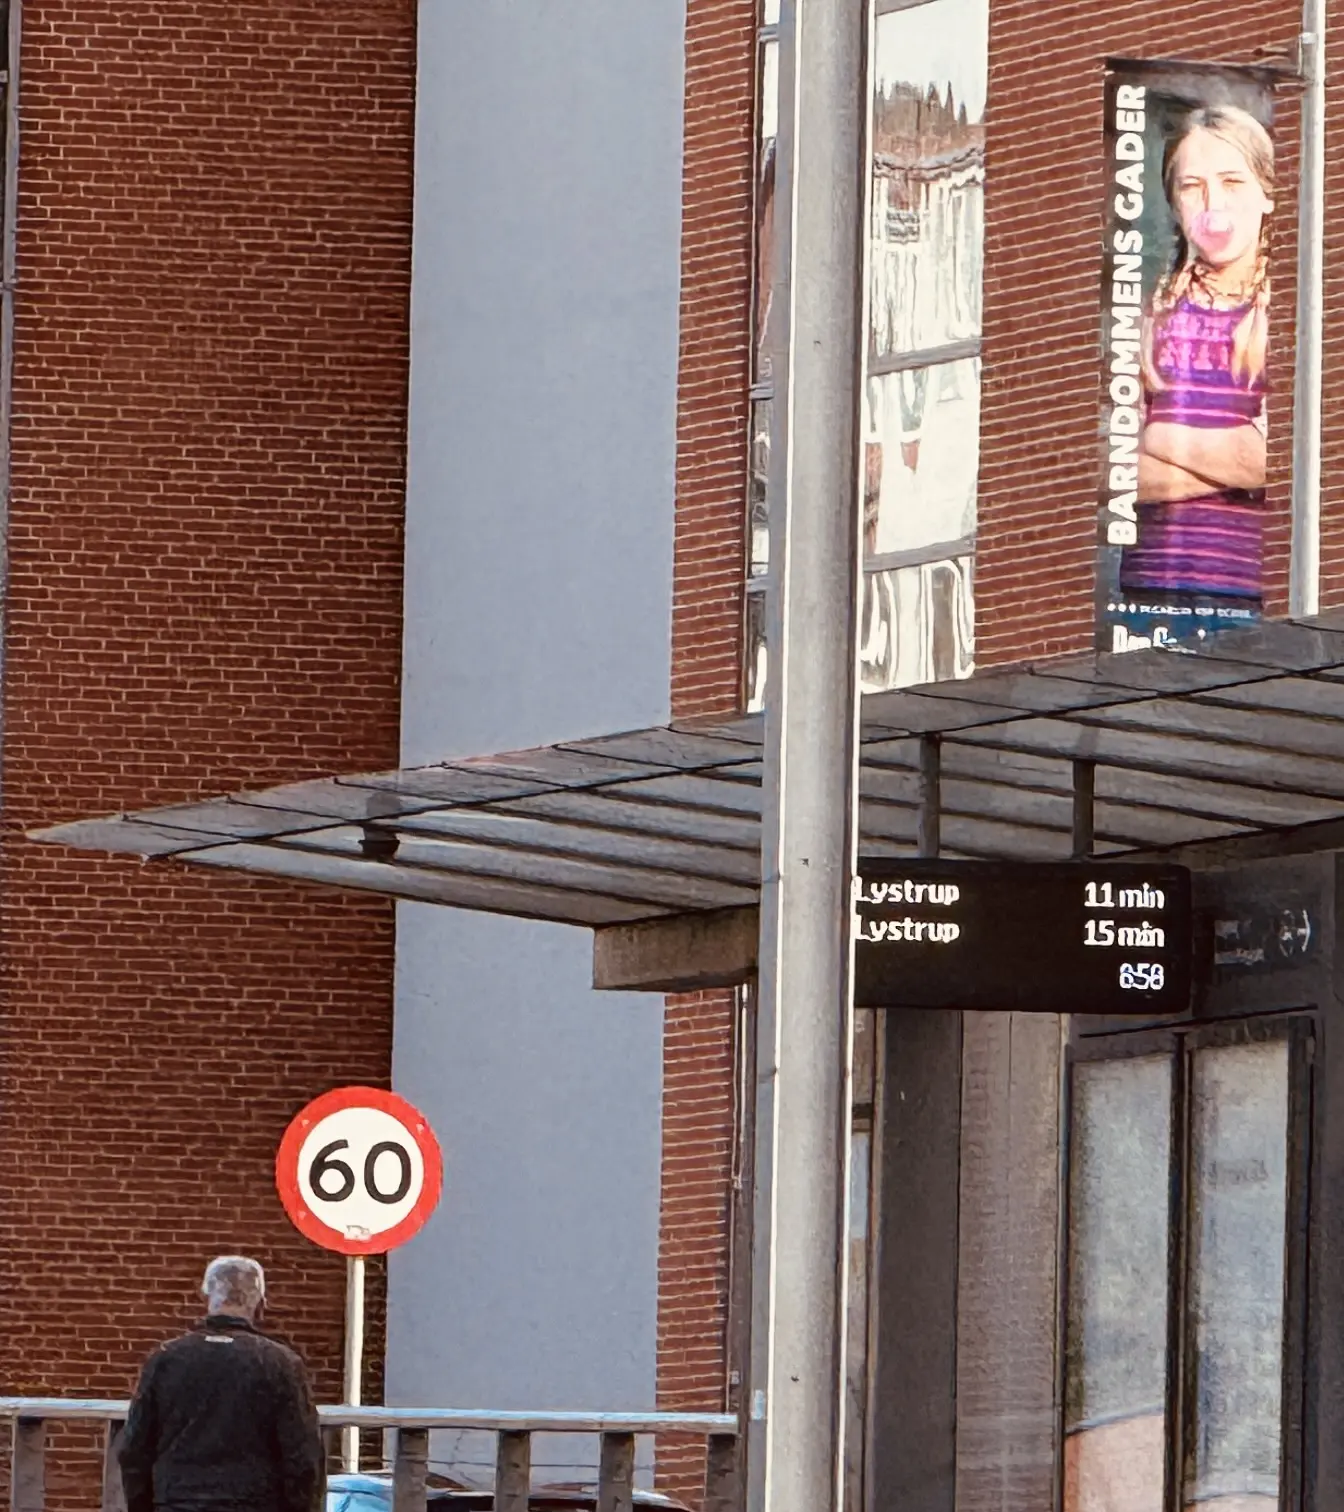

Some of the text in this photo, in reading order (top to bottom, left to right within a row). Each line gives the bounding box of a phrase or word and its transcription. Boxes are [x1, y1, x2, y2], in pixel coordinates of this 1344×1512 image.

[1107, 84, 1146, 546] BARNDOMMENS GADER
[855, 876, 1165, 909] Lystrup 11 min
[854, 914, 1165, 948] Lystrup 15 min
[309, 1138, 412, 1205] 60
